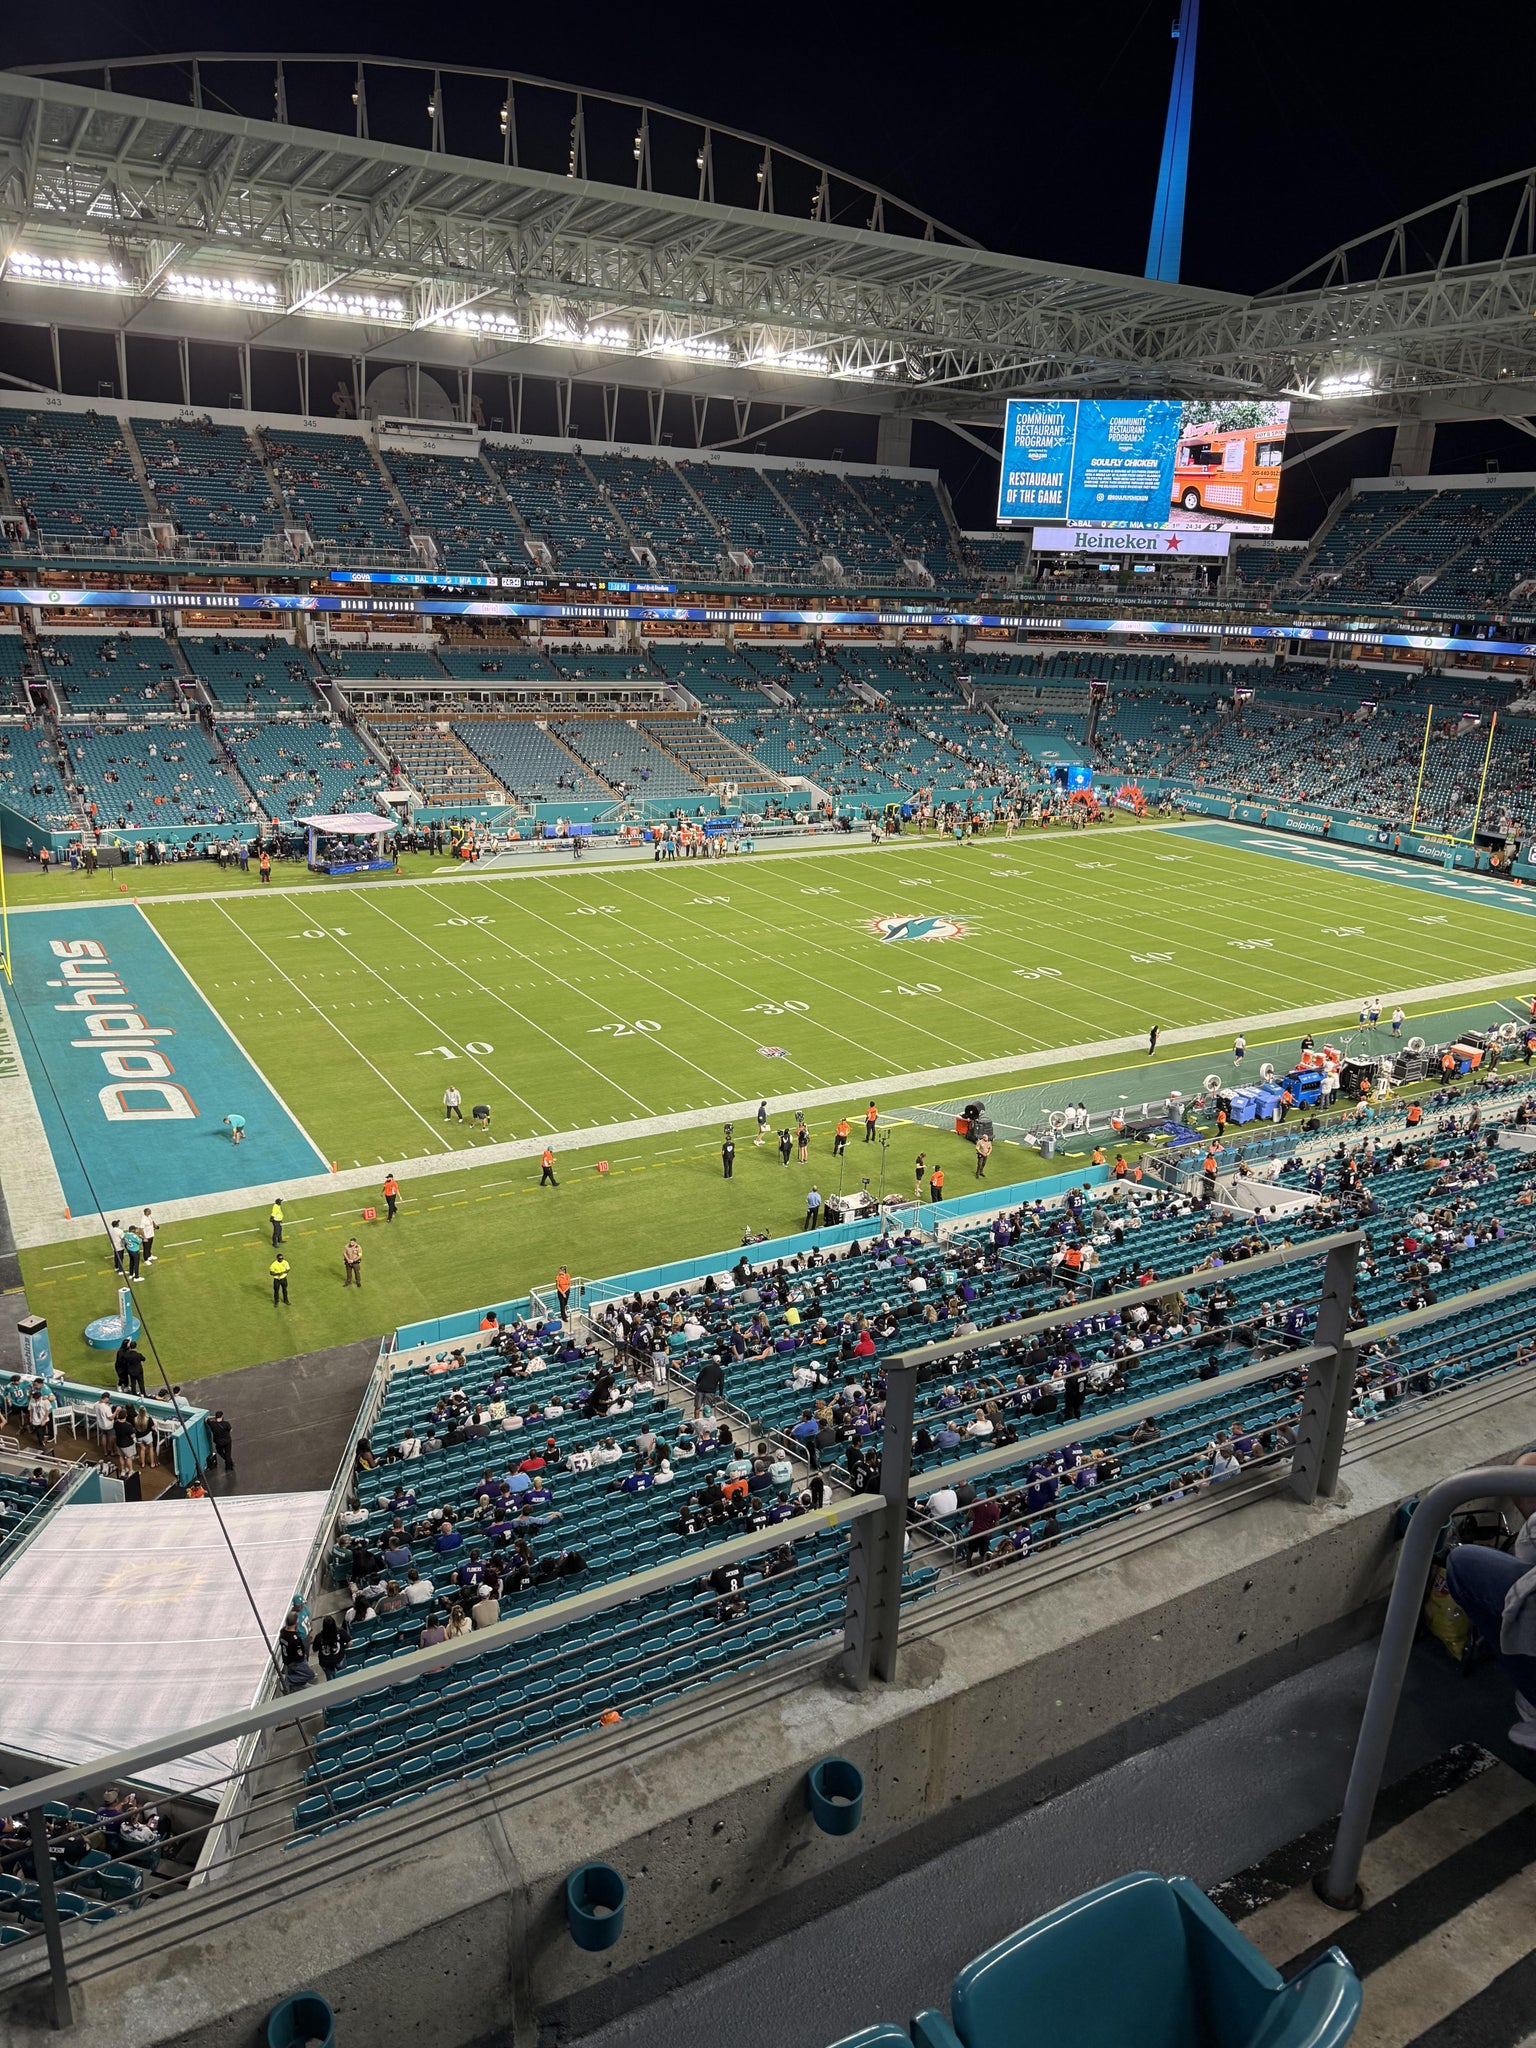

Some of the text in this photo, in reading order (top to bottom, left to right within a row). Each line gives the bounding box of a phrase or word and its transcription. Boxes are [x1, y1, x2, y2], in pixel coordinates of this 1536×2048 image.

[46, 397, 62, 406] 343
[179, 408, 194, 417] 344
[303, 419, 317, 428] 345
[1016, 413, 1066, 425] COMMUNITY
[1109, 417, 1147, 425] COMMUNITY
[1015, 424, 1065, 436] RESTAURANT
[1109, 425, 1146, 434] RESTAURANT
[1014, 435, 1054, 447] PROGRAM
[1108, 433, 1138, 442] PROGRAM
[423, 441, 436, 449] 346
[1091, 458, 1158, 467] SOULFLY CHICKEN
[1009, 472, 1064, 486] RESTAURANT
[1007, 489, 1063, 504] OF THE GAME
[1101, 520, 1106, 528] 0
[1129, 521, 1144, 529] MIA
[1074, 532, 1157, 550] Heineken
[351, 573, 372, 581] GOYA
[415, 575, 429, 583] BAL
[459, 577, 471, 585] MIA
[150, 595, 240, 607] BALTIMORE RAVENS
[340, 600, 415, 611] MIAMI DOLPHINS
[561, 607, 629, 617] BALTIMORE RAVENS
[705, 611, 762, 620] MIAMI DOLPHINS
[878, 615, 932, 623] BALTIMORE RAVENS
[1001, 617, 1061, 627] MIAMI DOLPHINS
[1182, 624, 1252, 635] BALTIMORE RAVENS
[1327, 631, 1384, 643] MIAMI DOLPHINS
[1285, 819, 1324, 833] Dolphins
[800, 886, 841, 896] 50
[693, 895, 732, 905] 40
[576, 904, 622, 916] 30
[446, 915, 496, 927] 20
[298, 927, 352, 939] 10
[1227, 937, 1267, 950] 30
[1130, 951, 1170, 965] 40
[1012, 966, 1063, 981] 50
[897, 982, 943, 997] 40
[754, 999, 811, 1016] 30
[46, 939, 201, 1121] Dolphins
[602, 1019, 662, 1037] 20
[434, 1040, 495, 1060] 10
[945, 1275, 954, 1285] 13
[573, 1459, 589, 1472] 52
[856, 1474, 864, 1488] 8
[688, 1524, 695, 1533] 8
[470, 1573, 477, 1585] 4
[725, 1569, 740, 1578] JACKSON
[730, 1578, 738, 1592] 8
